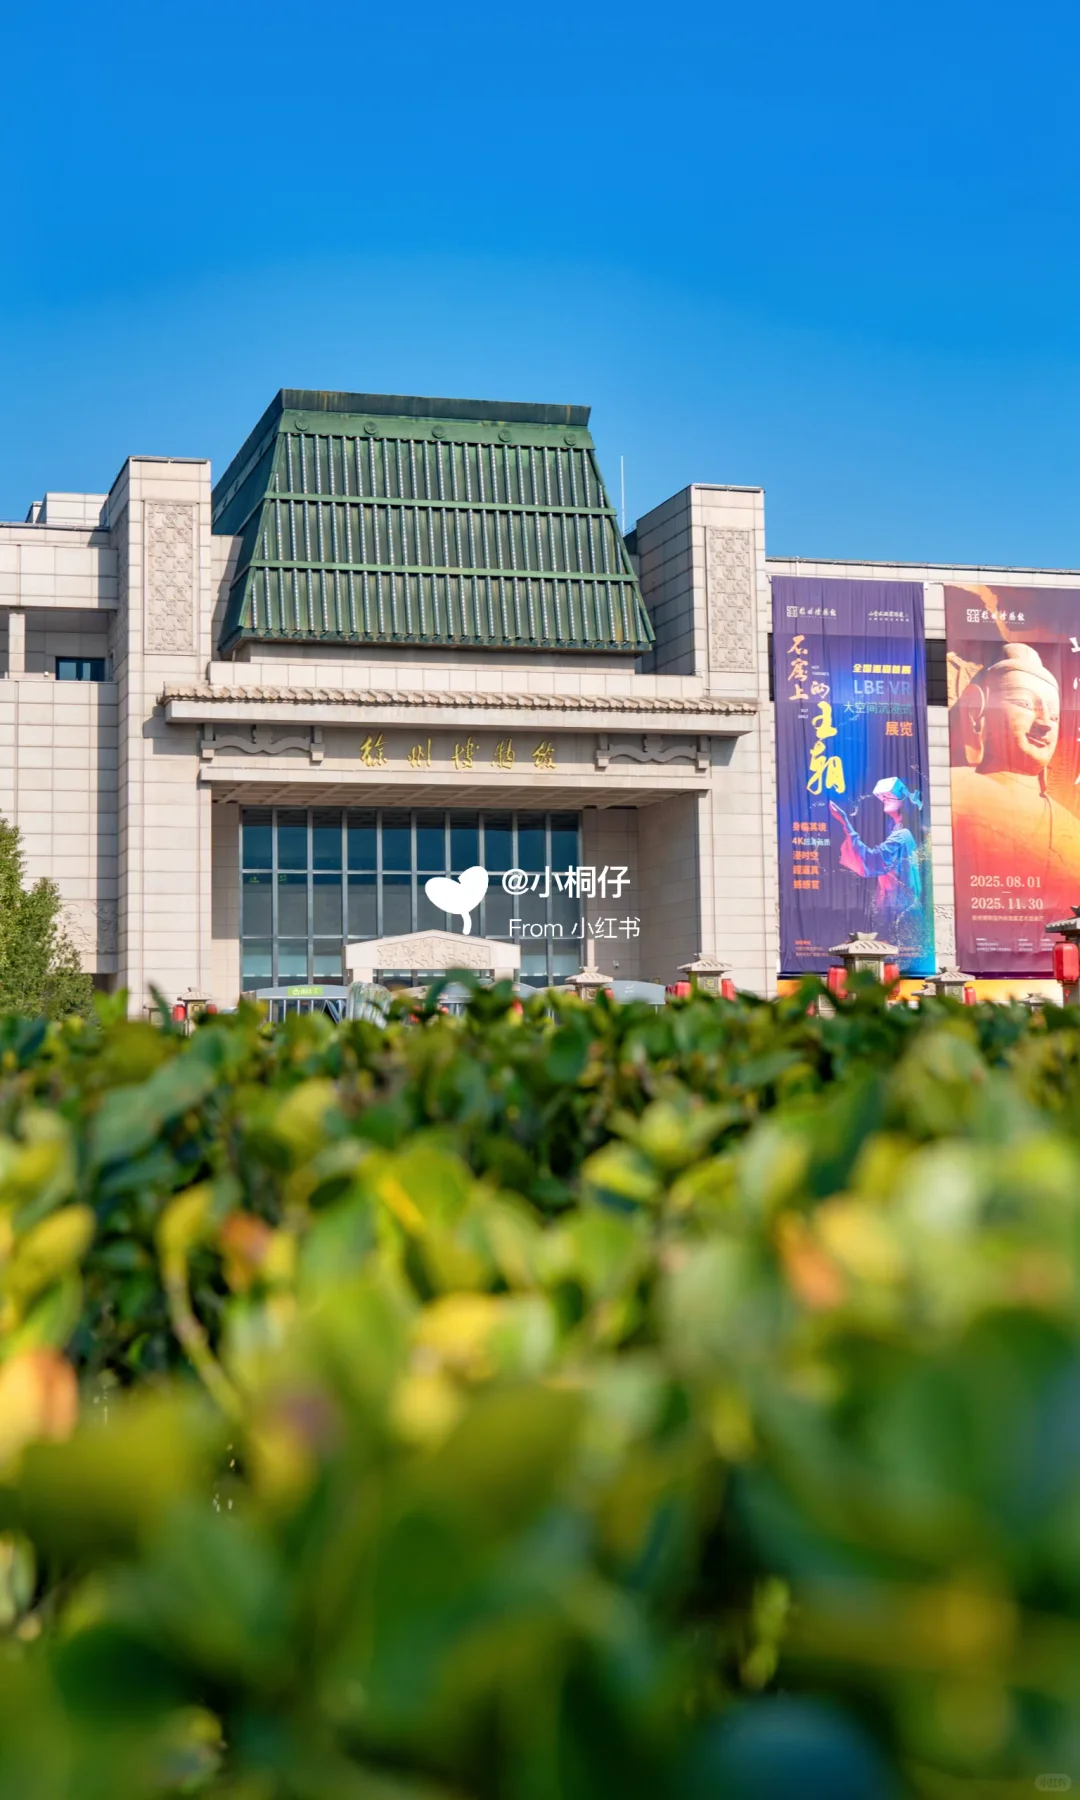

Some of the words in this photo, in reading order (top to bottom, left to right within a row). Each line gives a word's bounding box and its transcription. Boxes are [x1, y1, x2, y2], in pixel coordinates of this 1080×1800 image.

[853, 680, 884, 695] LBE
[889, 681, 911, 696] VR
[843, 701, 913, 716] 大空间沉浸式
[885, 721, 914, 737] 展览
[360, 732, 557, 769] 徐州博物馆
[970, 875, 1042, 888] 2025.08.01
[971, 897, 1044, 910] 2025.11.30
